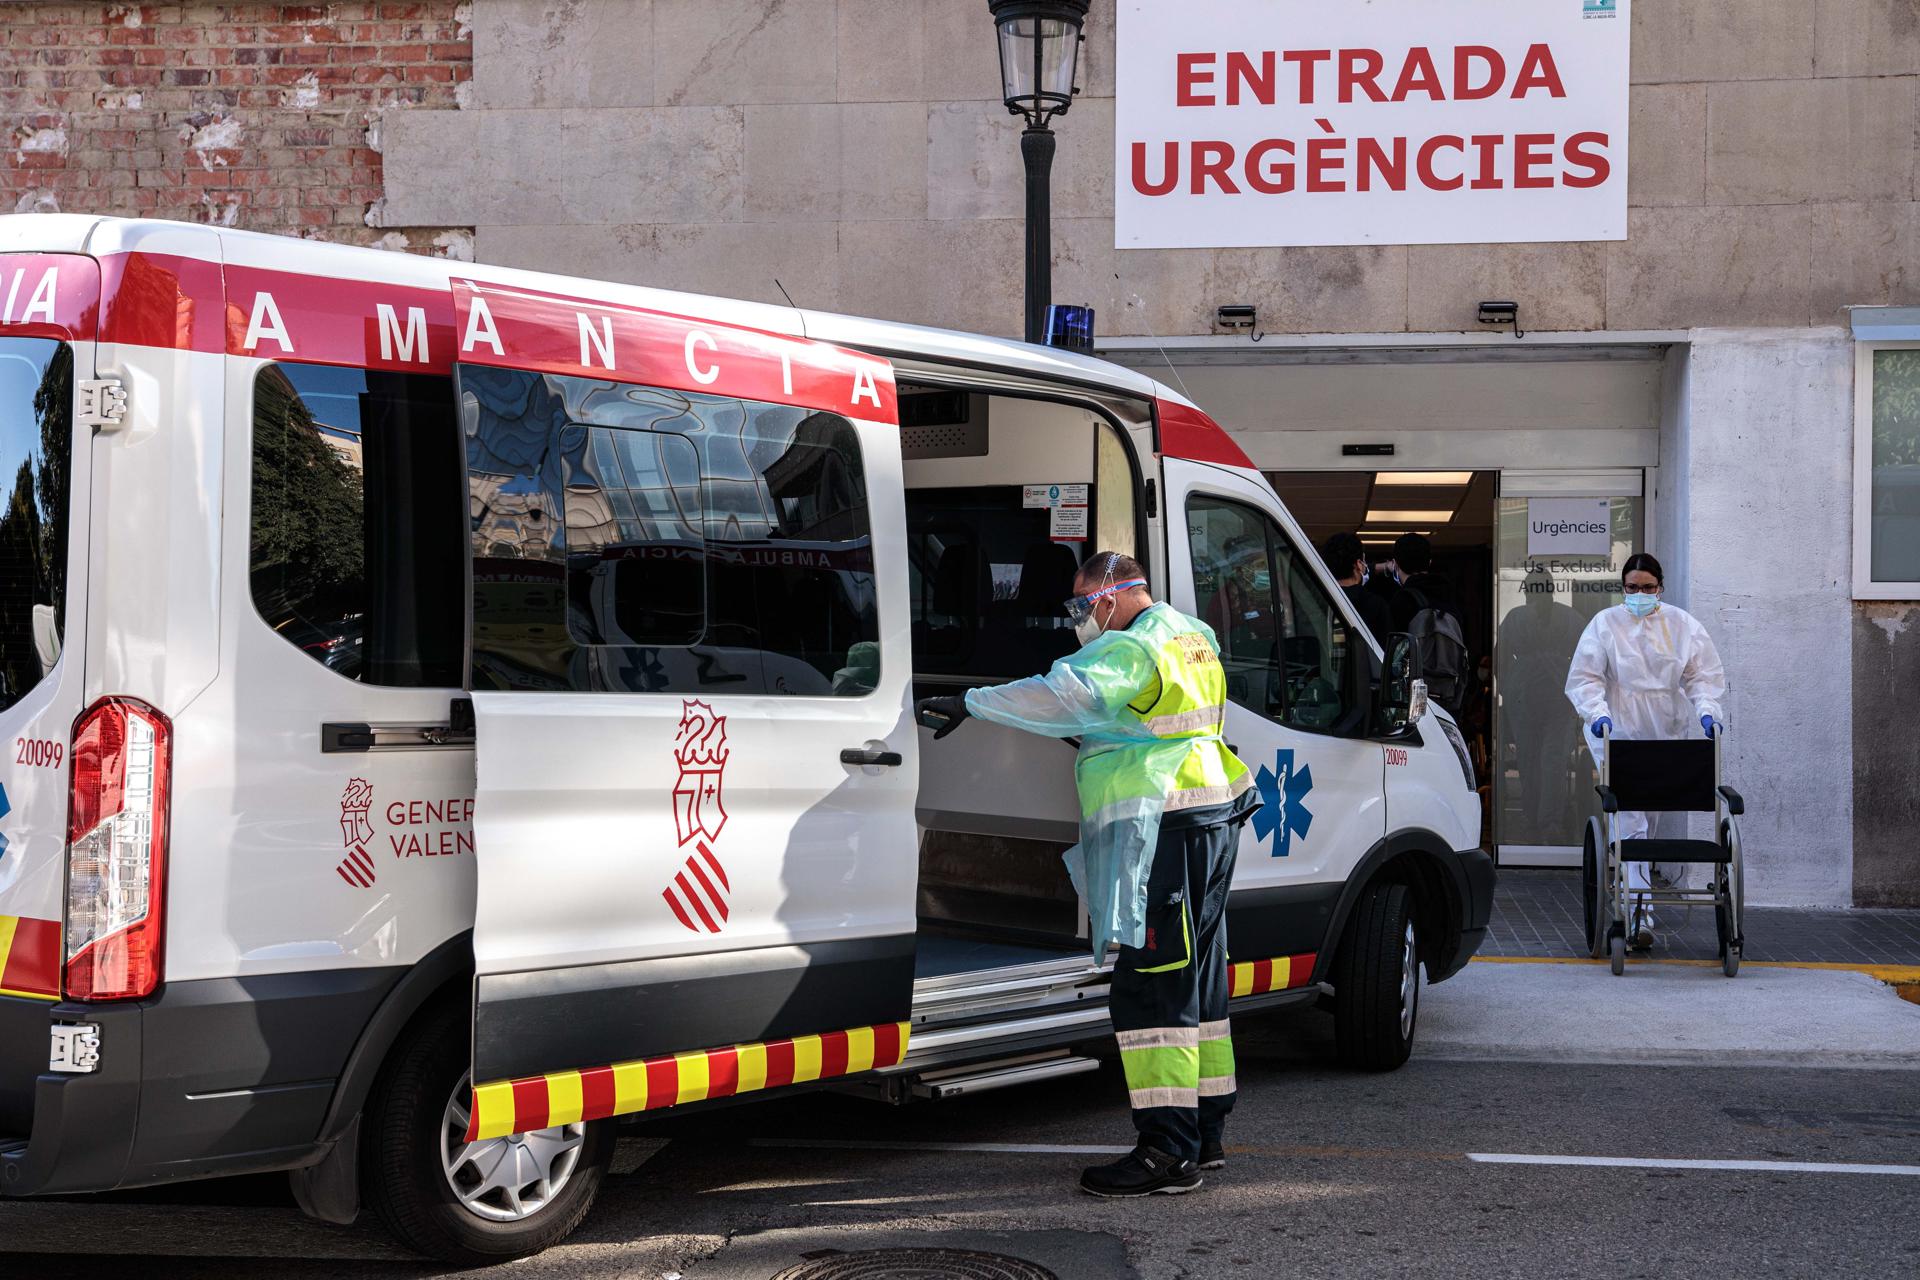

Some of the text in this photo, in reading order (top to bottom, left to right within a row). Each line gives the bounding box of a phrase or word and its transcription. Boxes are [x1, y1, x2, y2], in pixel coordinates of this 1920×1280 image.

[1176, 43, 1567, 107] ENTRADA
[1131, 118, 1612, 197] URGÈNCIES
[0, 266, 59, 325] IA
[1533, 520, 1607, 537] Urgències
[1524, 556, 1617, 574] Ús Exclusiu
[1092, 585, 1118, 599] uvex
[1519, 579, 1623, 593] Ambulàncies
[16, 738, 63, 769] 20099
[1386, 748, 1408, 766] 20099
[390, 830, 475, 859] VALEN
